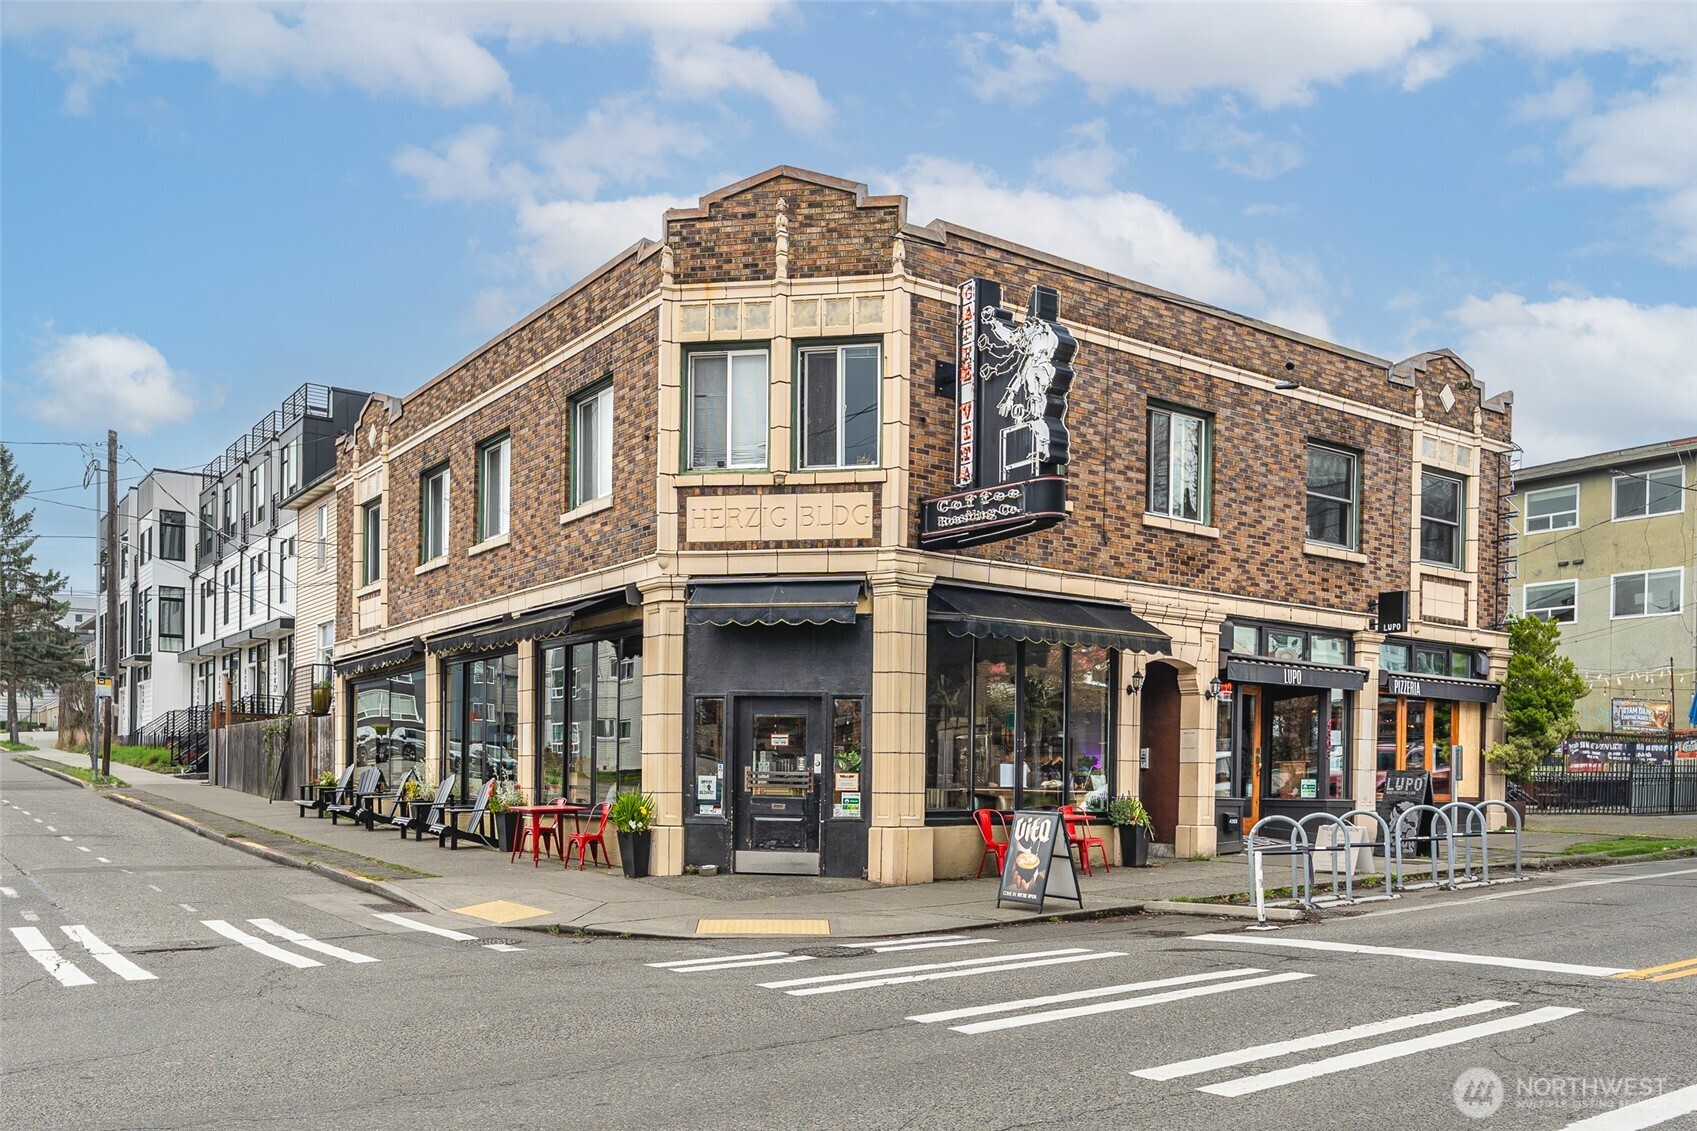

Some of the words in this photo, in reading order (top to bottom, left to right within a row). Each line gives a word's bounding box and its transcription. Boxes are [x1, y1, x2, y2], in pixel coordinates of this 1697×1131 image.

[959, 402, 972, 482] VITA
[937, 488, 1022, 513] Coffee
[690, 506, 788, 530] HERZIG
[799, 503, 871, 527] BLDG
[1383, 622, 1402, 632] LUPO
[1283, 668, 1302, 685] LUPO
[1394, 679, 1421, 696] PIZZERIA
[1386, 777, 1423, 791] LUPO
